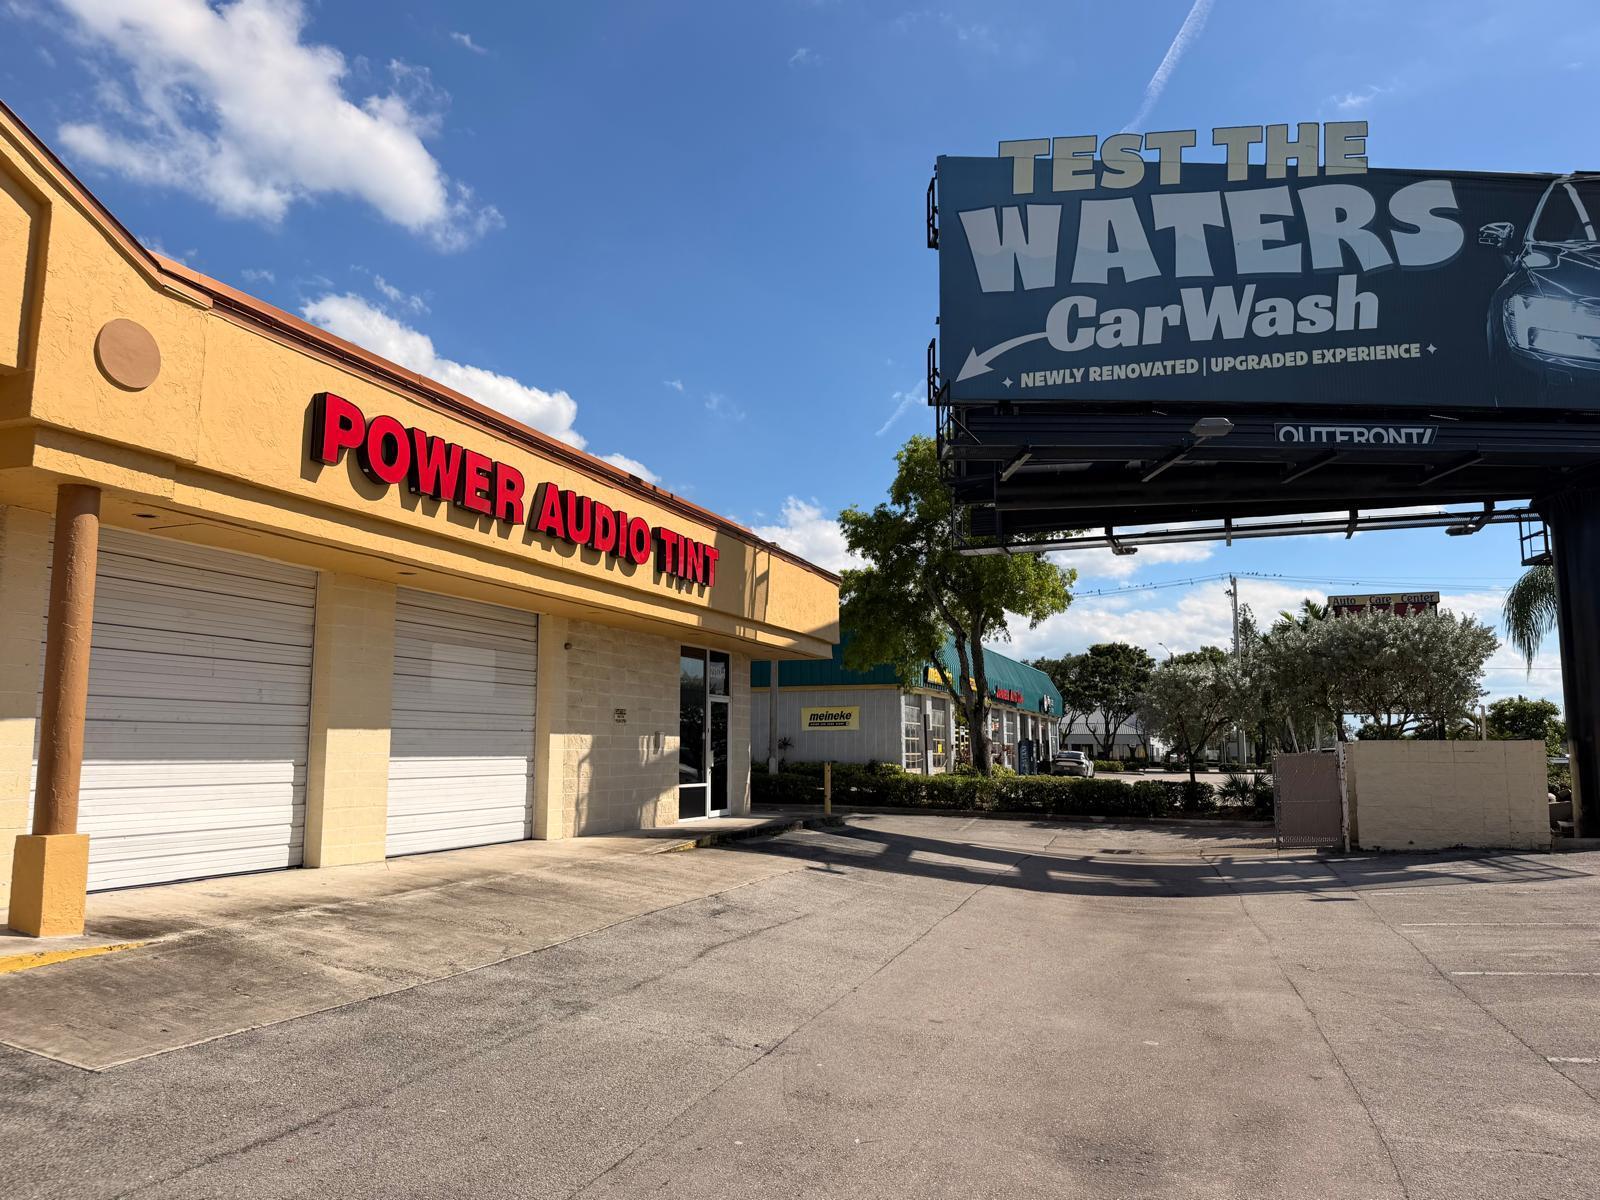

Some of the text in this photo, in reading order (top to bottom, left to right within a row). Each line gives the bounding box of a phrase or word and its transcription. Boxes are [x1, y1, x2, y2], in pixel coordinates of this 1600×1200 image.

[998, 120, 1369, 195] TEST THE
[958, 179, 1465, 294] WATERS
[1020, 367, 1085, 388] NEWLY
[1089, 358, 1199, 382] RENOVATED
[1210, 350, 1308, 372] UPGRADED
[1312, 343, 1421, 364] EXPERIENCE
[313, 391, 719, 587] POWER AUDIO TINT
[1334, 593, 1435, 606] Auto Care Center
[809, 710, 853, 722] meineke
